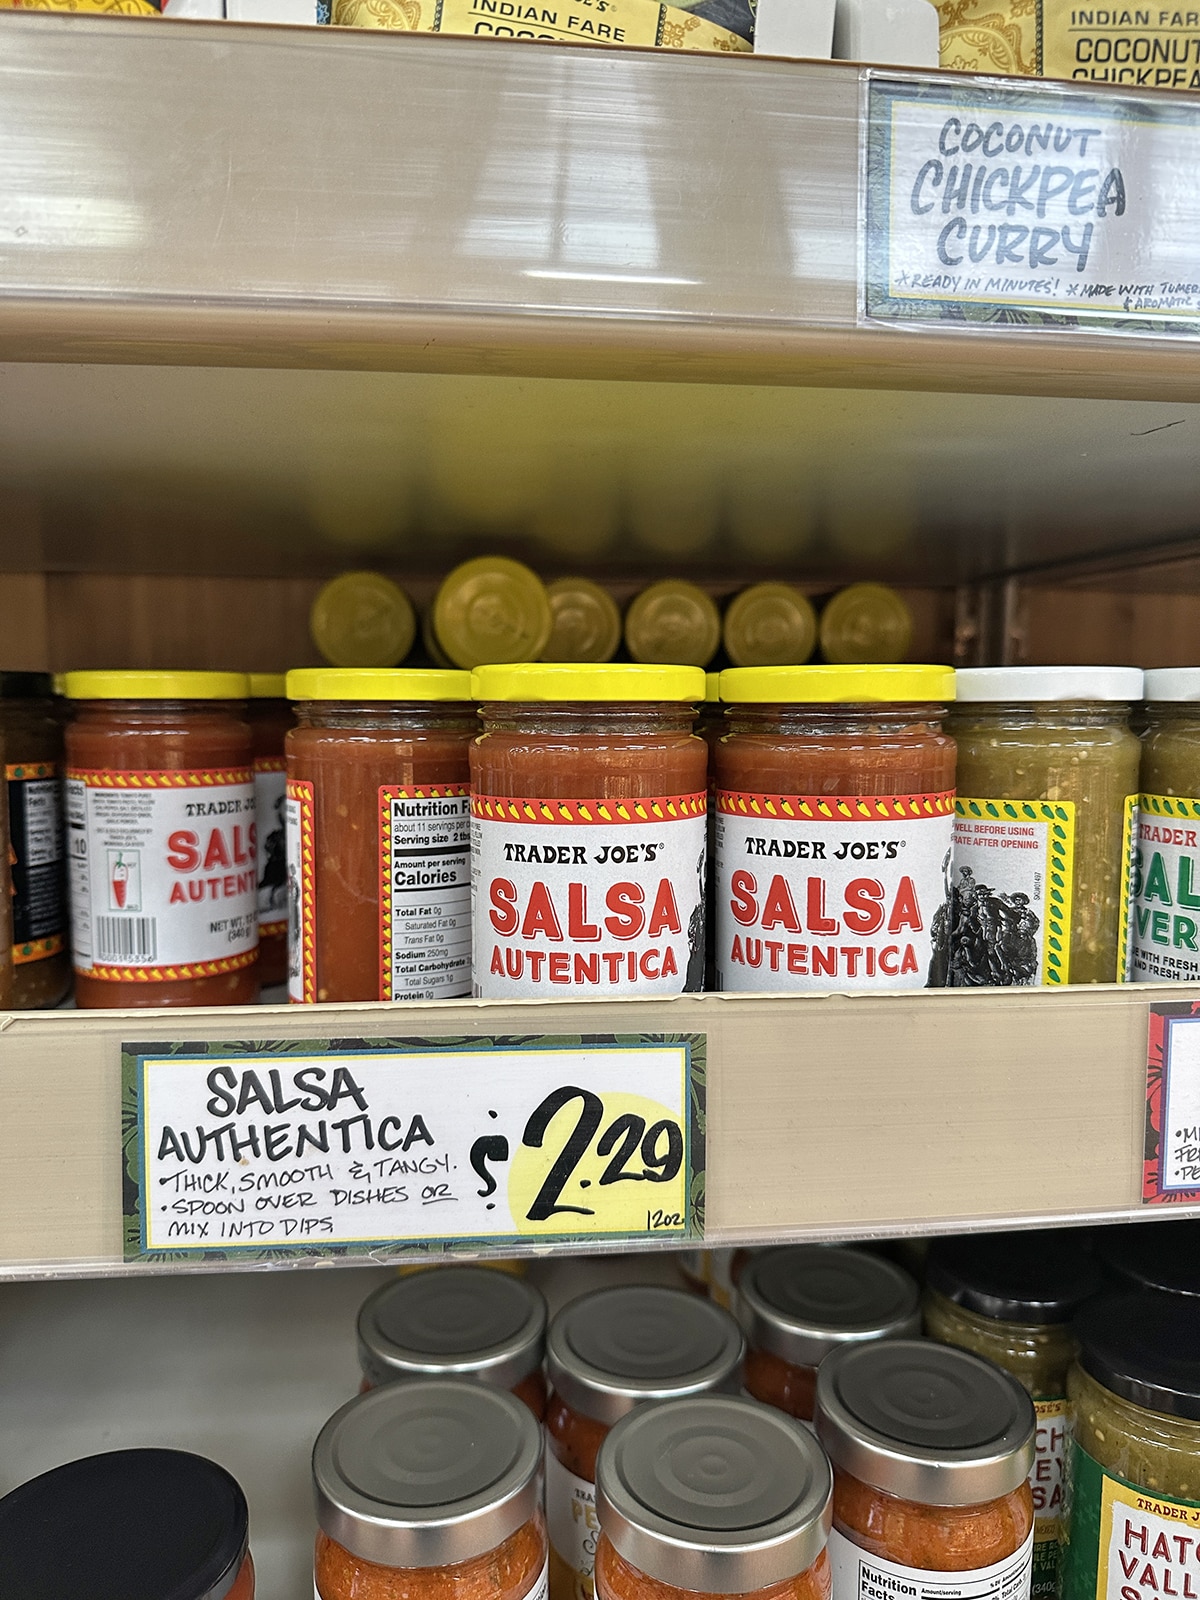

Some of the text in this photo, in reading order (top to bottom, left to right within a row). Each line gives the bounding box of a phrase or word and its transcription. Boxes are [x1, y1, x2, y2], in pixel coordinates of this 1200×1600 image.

[473, 0, 557, 24] INDIAN
[568, 16, 625, 42] FARE
[1072, 11, 1149, 25] INDIAN
[1076, 38, 1200, 63] COCONUT
[939, 117, 1102, 158] COCONUT
[911, 159, 1126, 219] CHICKPEA
[937, 216, 1094, 272] CURRY
[910, 274, 963, 291] READY
[964, 277, 981, 291] IN
[1080, 283, 1116, 297] MADE
[1118, 284, 1154, 296] WITH
[186, 800, 242, 817] TRADER
[394, 801, 458, 816] Nutrition
[394, 822, 416, 832] about
[428, 820, 455, 832] servings
[974, 825, 1006, 835] BEFORE
[1008, 827, 1035, 836] USING
[1139, 824, 1198, 847] TRADER
[394, 834, 430, 845] Serving
[432, 833, 449, 843] size
[453, 832, 459, 841] 2
[744, 837, 827, 860] TRADER
[973, 838, 999, 847] AFTER
[1001, 840, 1039, 850] OPENING
[394, 857, 466, 869] Amount per serving
[503, 843, 588, 864] TRADER
[394, 869, 457, 886] Calories
[395, 906, 442, 917] Total Fat 0g
[489, 877, 682, 942] SALSA
[730, 870, 924, 936] SALSA
[210, 920, 229, 933] NET
[405, 918, 456, 931] Saturated Fat 0g
[404, 933, 444, 945] Trans Fat 0g
[395, 948, 449, 960] Sodium 250mg
[731, 935, 919, 978] AUTENTICA
[1141, 948, 1160, 964] WITH
[1163, 956, 1199, 973] FRESH
[395, 965, 417, 974] Total
[418, 959, 466, 972] Carbohydrate
[490, 945, 678, 984] AUTENTICA
[1149, 965, 1180, 981] FRESH
[405, 977, 422, 986] Total
[423, 975, 445, 986] Sugars
[395, 990, 434, 1001] Protein 0g
[207, 1067, 370, 1117] SALSA
[157, 1114, 436, 1163] AUTHENTICA
[172, 1182, 452, 1215] SPOON OVER DISHES OR
[167, 1219, 210, 1238] MIX
[220, 1219, 274, 1238] INTO
[1137, 1498, 1188, 1520] TRADER
[862, 1565, 917, 1597] Nutrition
[1119, 1549, 1198, 1599] VALL
[862, 1580, 895, 1600] Facts
[921, 1587, 962, 1597] Amount/serving
